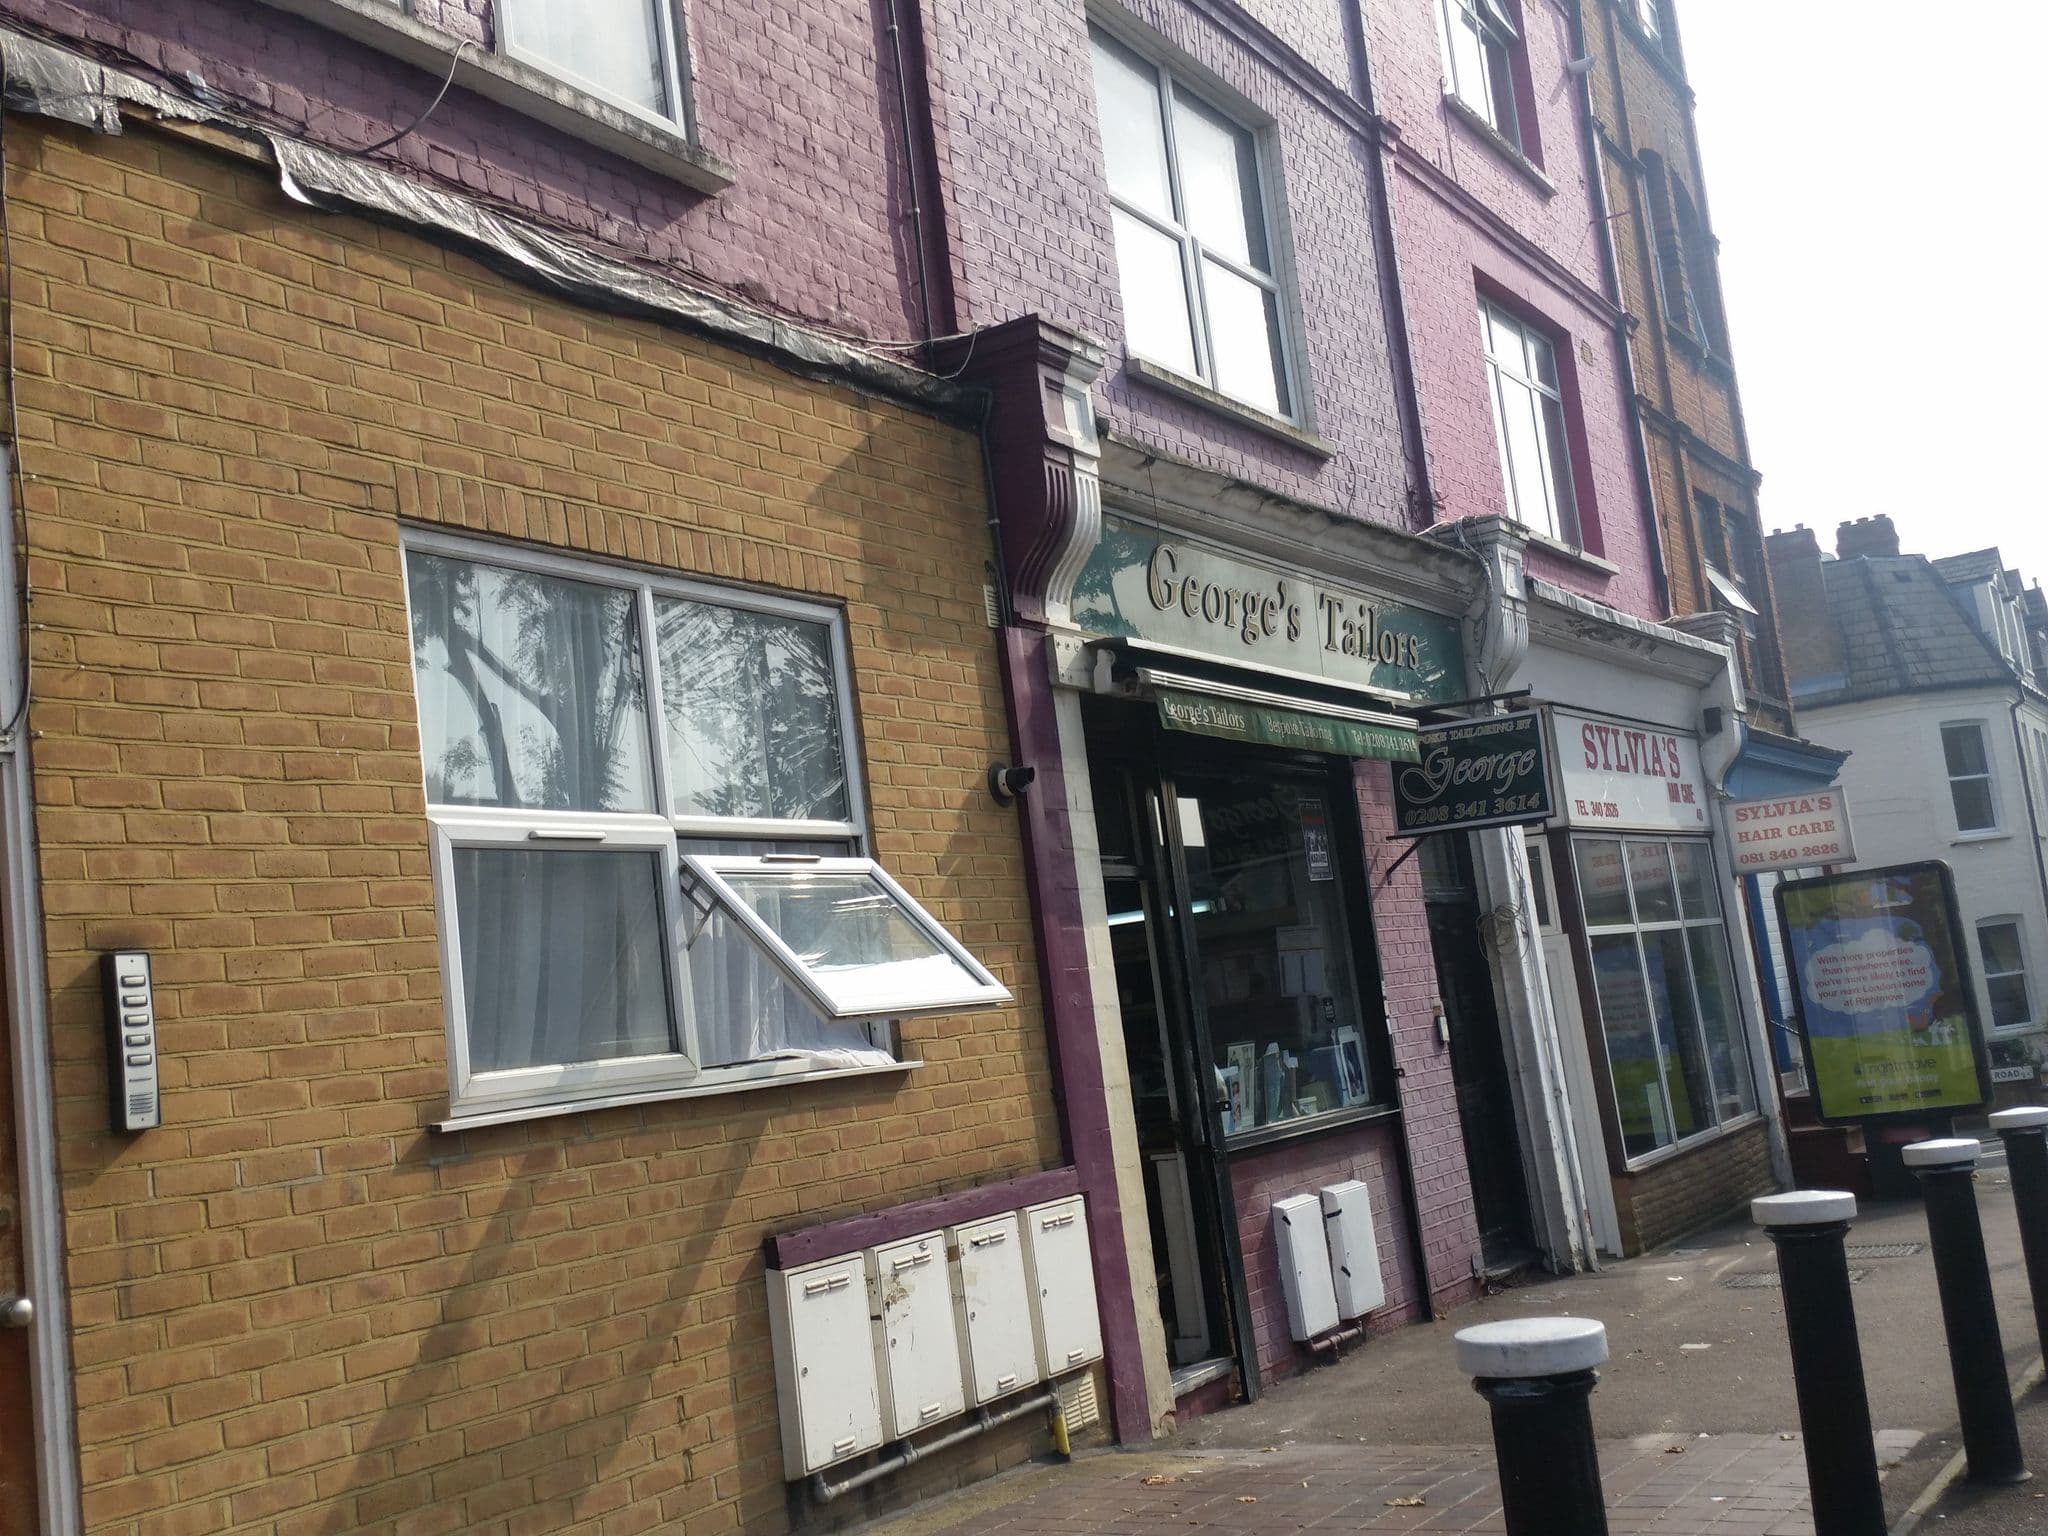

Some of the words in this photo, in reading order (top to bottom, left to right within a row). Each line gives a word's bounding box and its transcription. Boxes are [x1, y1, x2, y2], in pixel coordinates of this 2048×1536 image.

[1147, 543, 1300, 645] George's
[1319, 592, 1420, 670] Tailors
[1163, 698, 1209, 726] George's
[1209, 705, 1246, 729] Tailors
[1266, 716, 1300, 738] Bespoke
[1299, 720, 1334, 744] Tailoring
[1416, 731, 1448, 745] POKE
[1450, 721, 1515, 740] TAILORING
[1516, 718, 1533, 730] BY
[1581, 722, 1681, 779] SYLVIA'S
[1400, 746, 1537, 804] George
[1404, 805, 1449, 826] 0208
[1454, 799, 1487, 820] 341
[1493, 792, 1540, 815] 3614
[1574, 799, 1589, 816] TEL
[1735, 796, 1832, 822] SYLVIA'S
[1737, 827, 1783, 843] HAIR
[1787, 820, 1836, 837] CARE
[1740, 853, 1765, 864] 081
[1769, 848, 1798, 861] 340
[1802, 843, 1840, 857] 2626
[1817, 954, 1839, 966] With
[1866, 946, 1914, 961] properties
[1822, 966, 1843, 977] than
[1895, 968, 1905, 978] to
[1907, 966, 1927, 977] find
[1818, 990, 1838, 1001] your
[1862, 982, 1898, 994] London
[1900, 979, 1927, 991] home
[1843, 997, 1853, 1007] at
[1855, 993, 1905, 1007] Rightmove
[1994, 1069, 2020, 1080] ROAD
